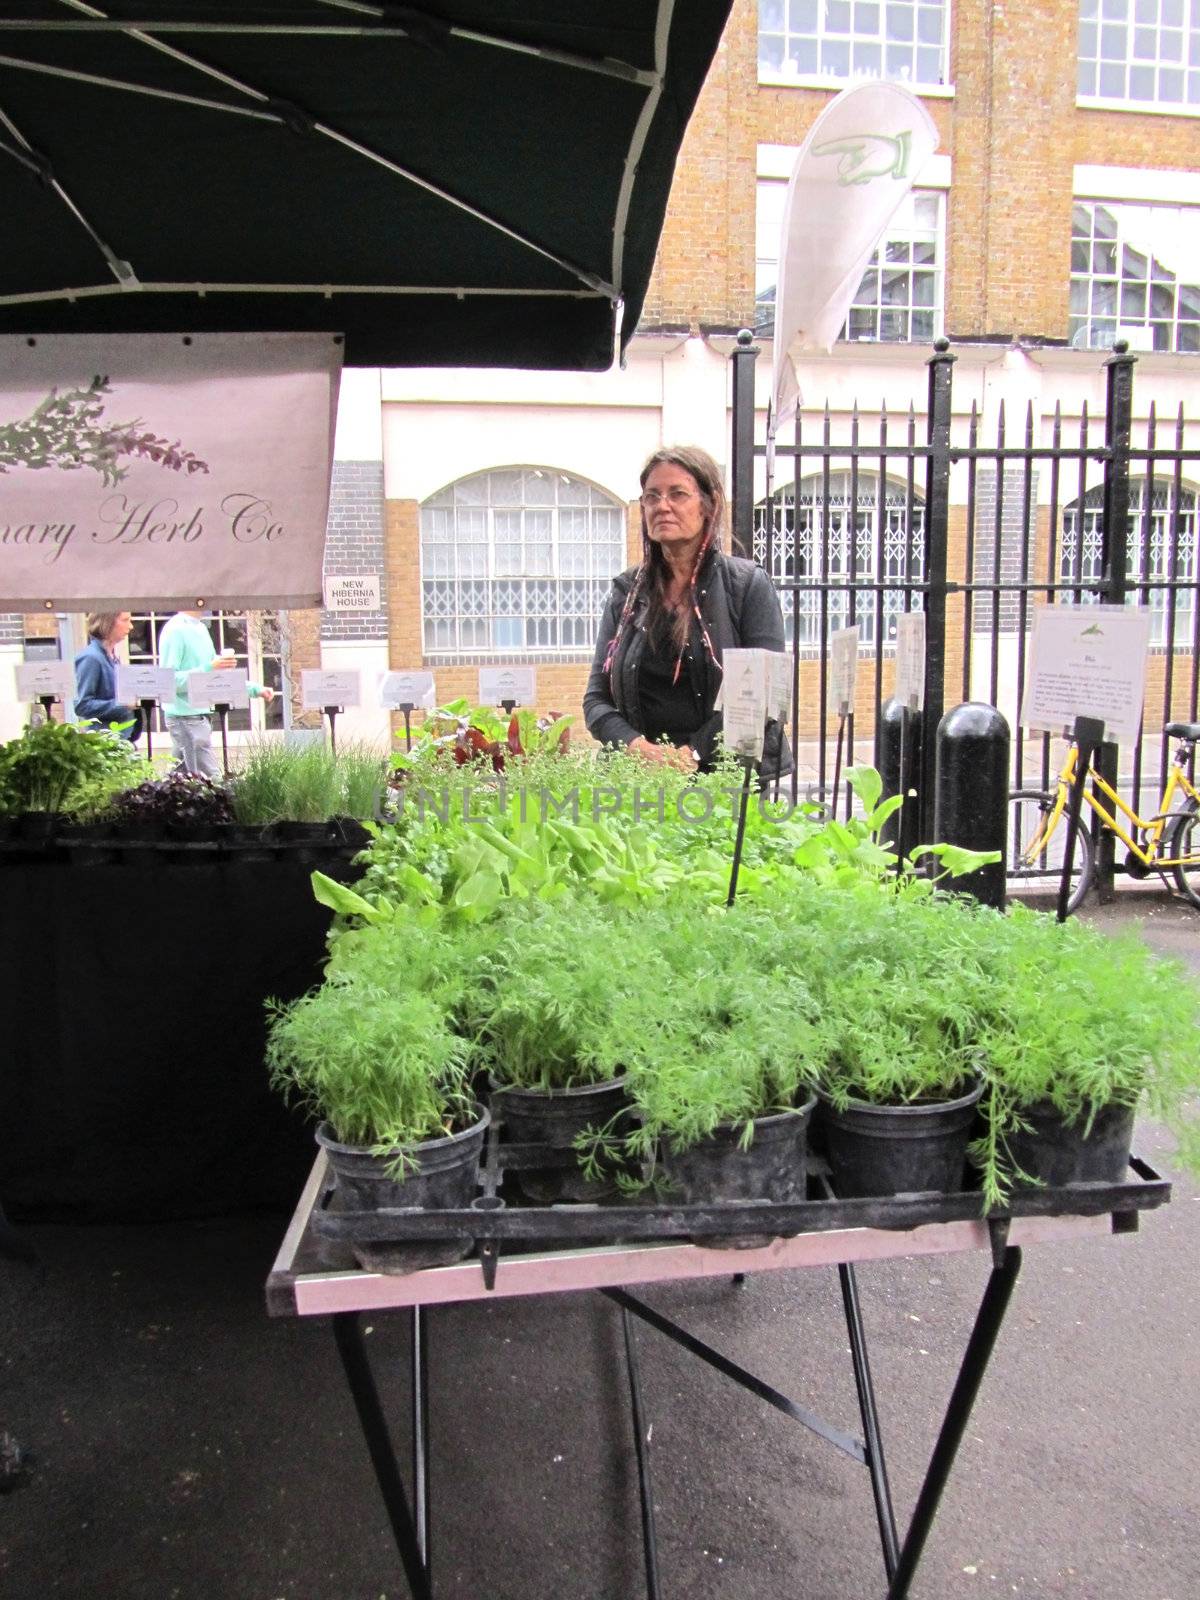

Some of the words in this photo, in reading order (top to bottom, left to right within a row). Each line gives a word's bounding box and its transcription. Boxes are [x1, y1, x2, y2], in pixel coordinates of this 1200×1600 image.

[92, 493, 203, 545] Herb
[220, 492, 285, 544] Co
[342, 580, 364, 589] NEW
[332, 589, 375, 598] HIBERNIA
[336, 598, 370, 607] HOUSE
